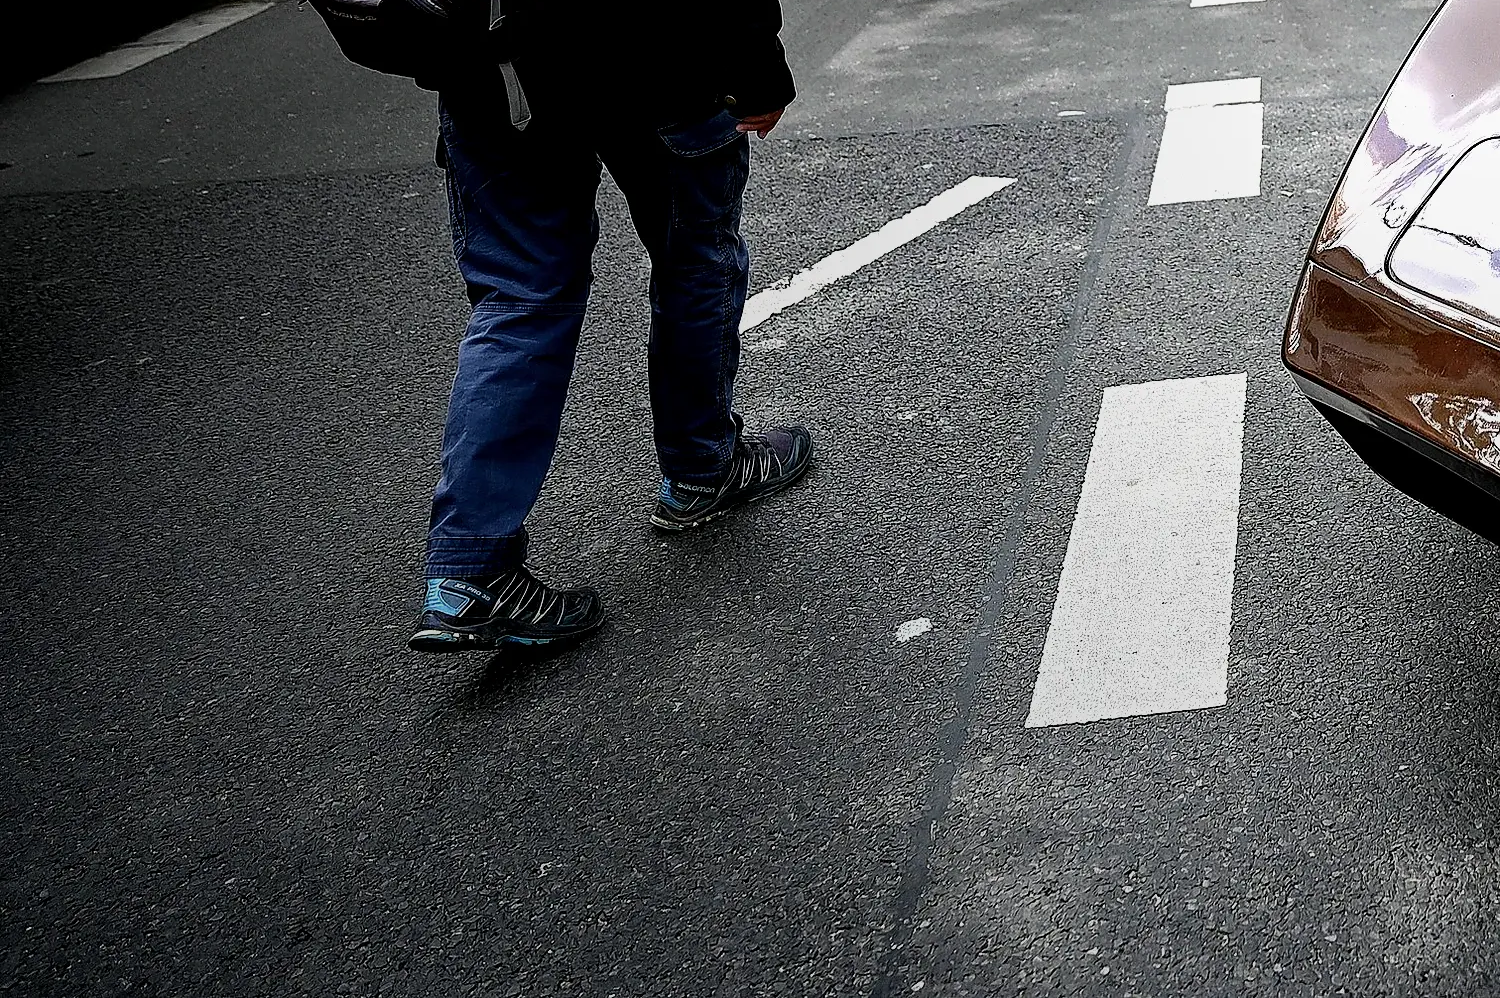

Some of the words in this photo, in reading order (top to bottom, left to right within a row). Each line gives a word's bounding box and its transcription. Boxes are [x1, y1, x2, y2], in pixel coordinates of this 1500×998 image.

[454, 582, 467, 590] XA
[466, 586, 482, 596] PRO
[481, 593, 491, 602] 3D
